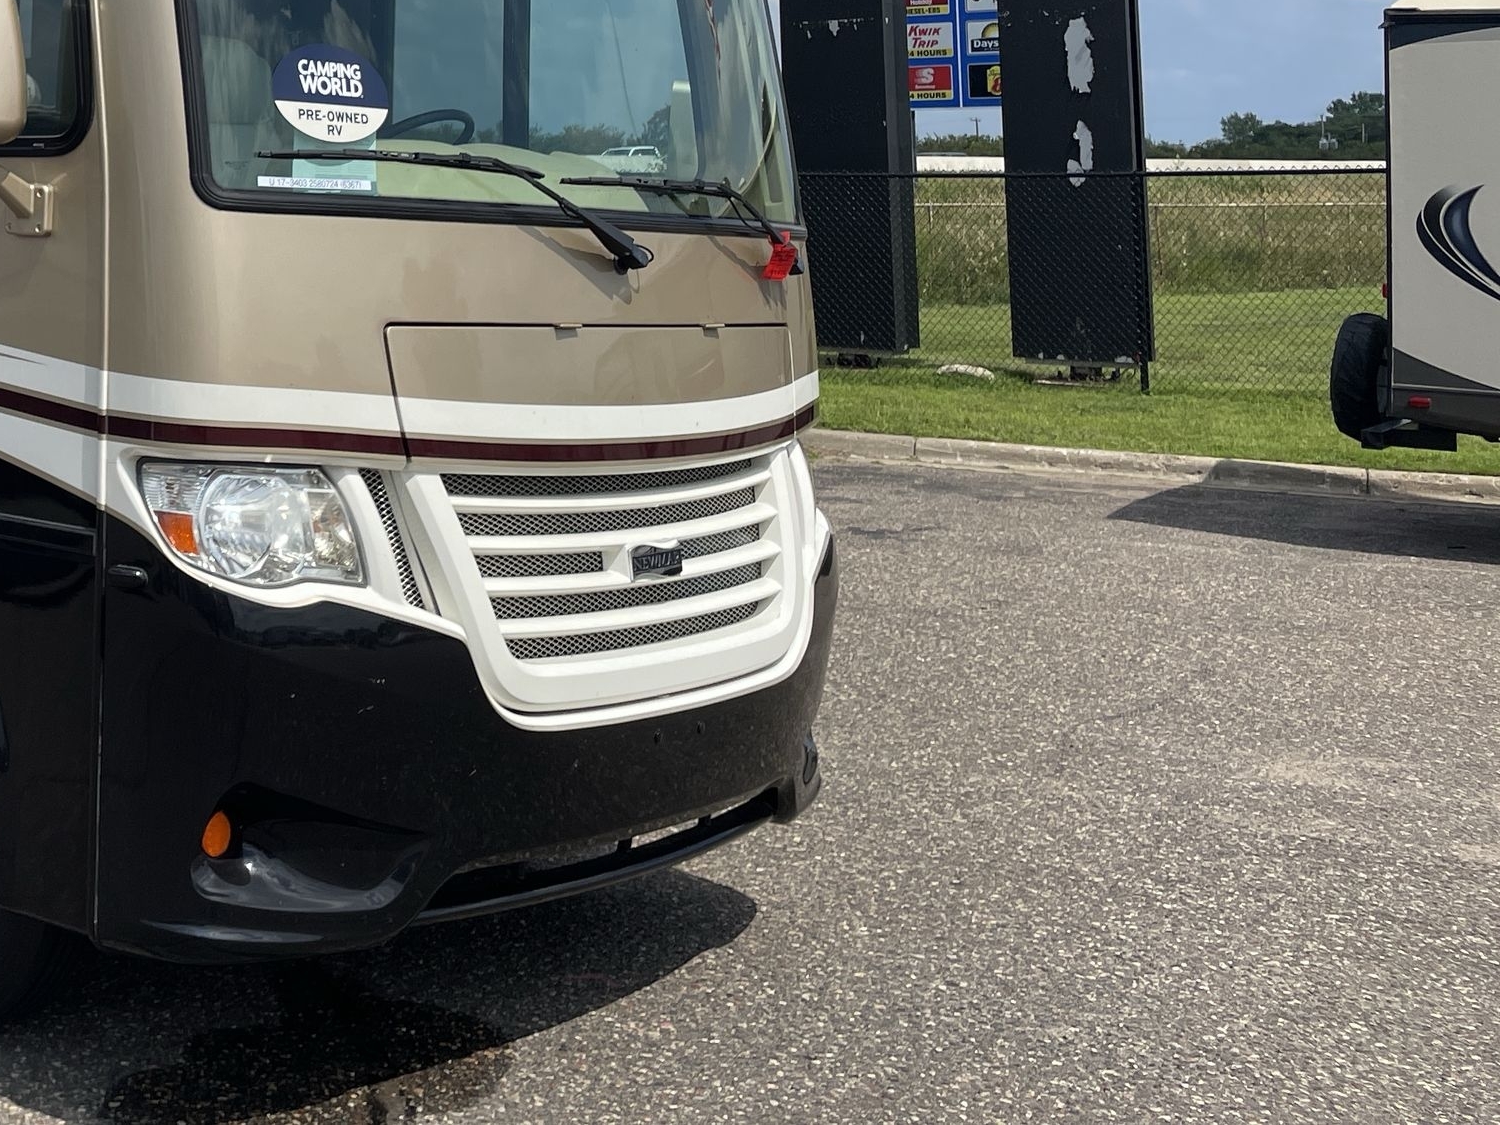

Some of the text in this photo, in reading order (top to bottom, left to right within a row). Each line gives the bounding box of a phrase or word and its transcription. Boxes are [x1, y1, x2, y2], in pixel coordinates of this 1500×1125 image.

[908, 25, 942, 37] KWIK
[912, 37, 939, 49] TRIP
[973, 39, 999, 49] Days
[916, 49, 947, 57] HOURS
[297, 59, 362, 81] CAMPING
[916, 91, 947, 99] HOURS
[298, 108, 369, 124] PRE-OWNED
[327, 125, 343, 136] RV
